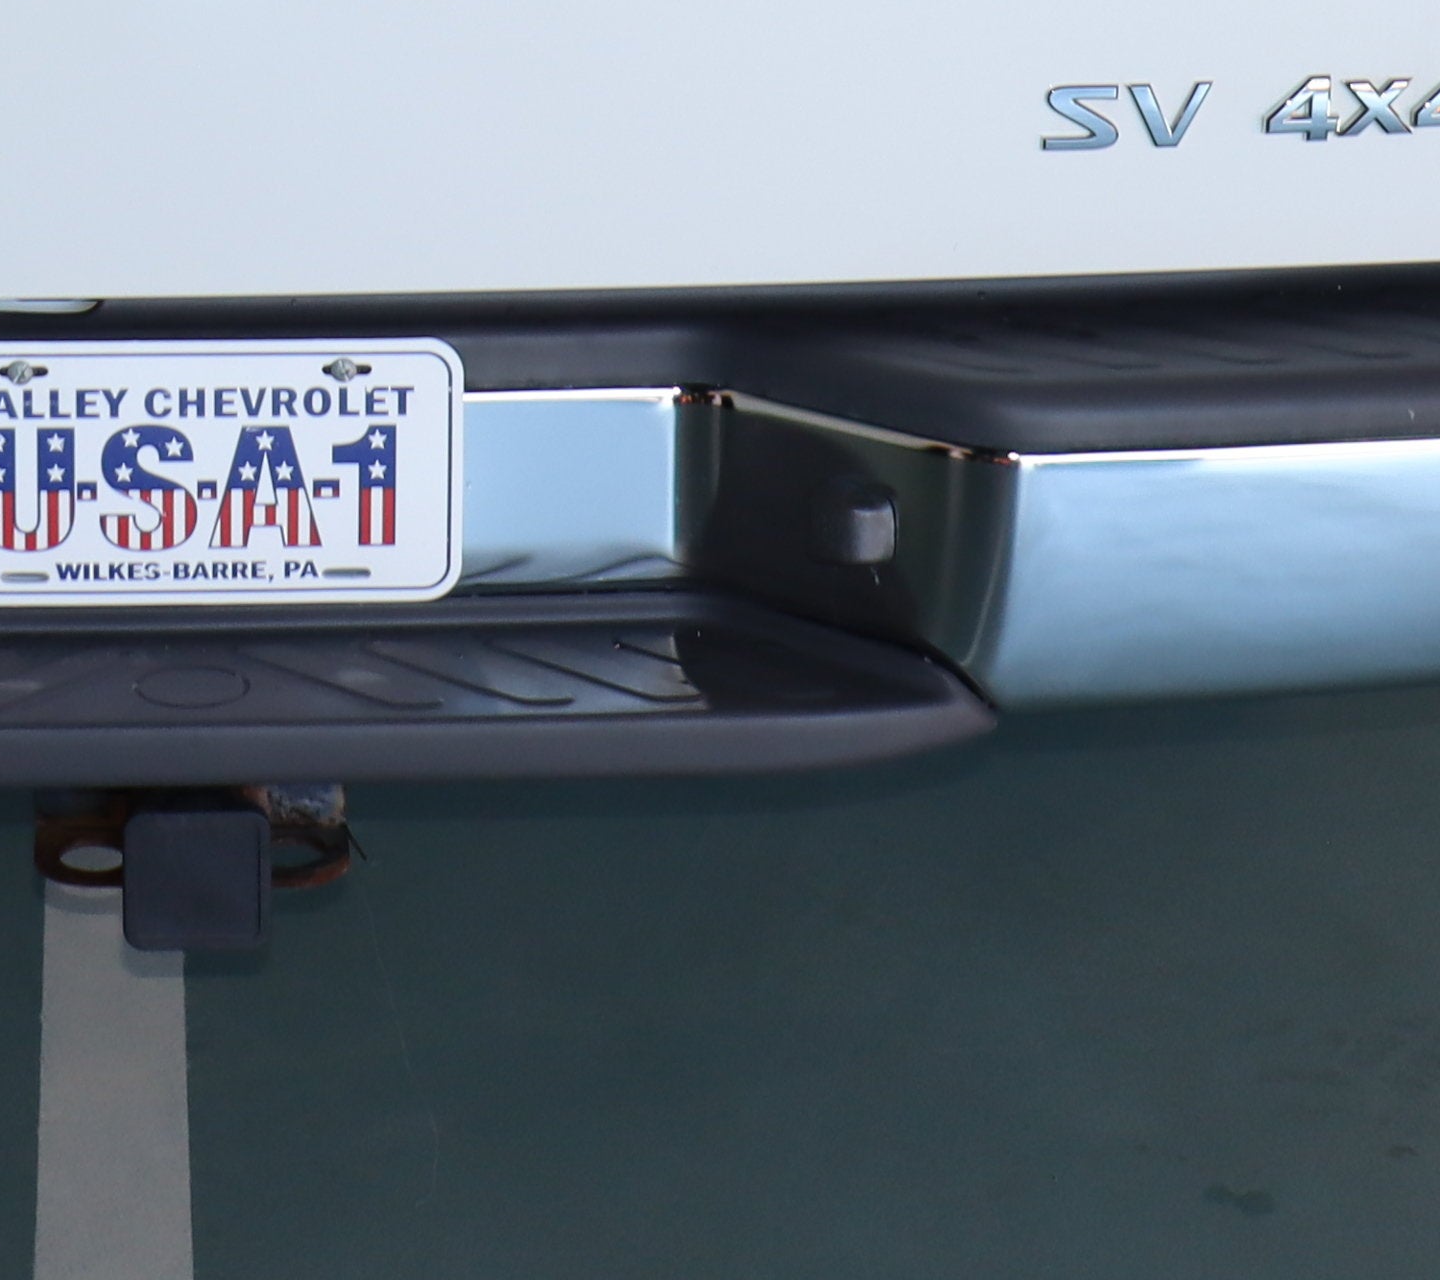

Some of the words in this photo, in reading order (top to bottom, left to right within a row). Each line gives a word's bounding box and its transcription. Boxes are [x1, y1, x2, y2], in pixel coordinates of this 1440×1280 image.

[1041, 80, 1214, 151] SV
[144, 385, 415, 418] CHEVROLET
[55, 561, 275, 584] WILKES-BARRE,
[283, 560, 319, 580] PA
